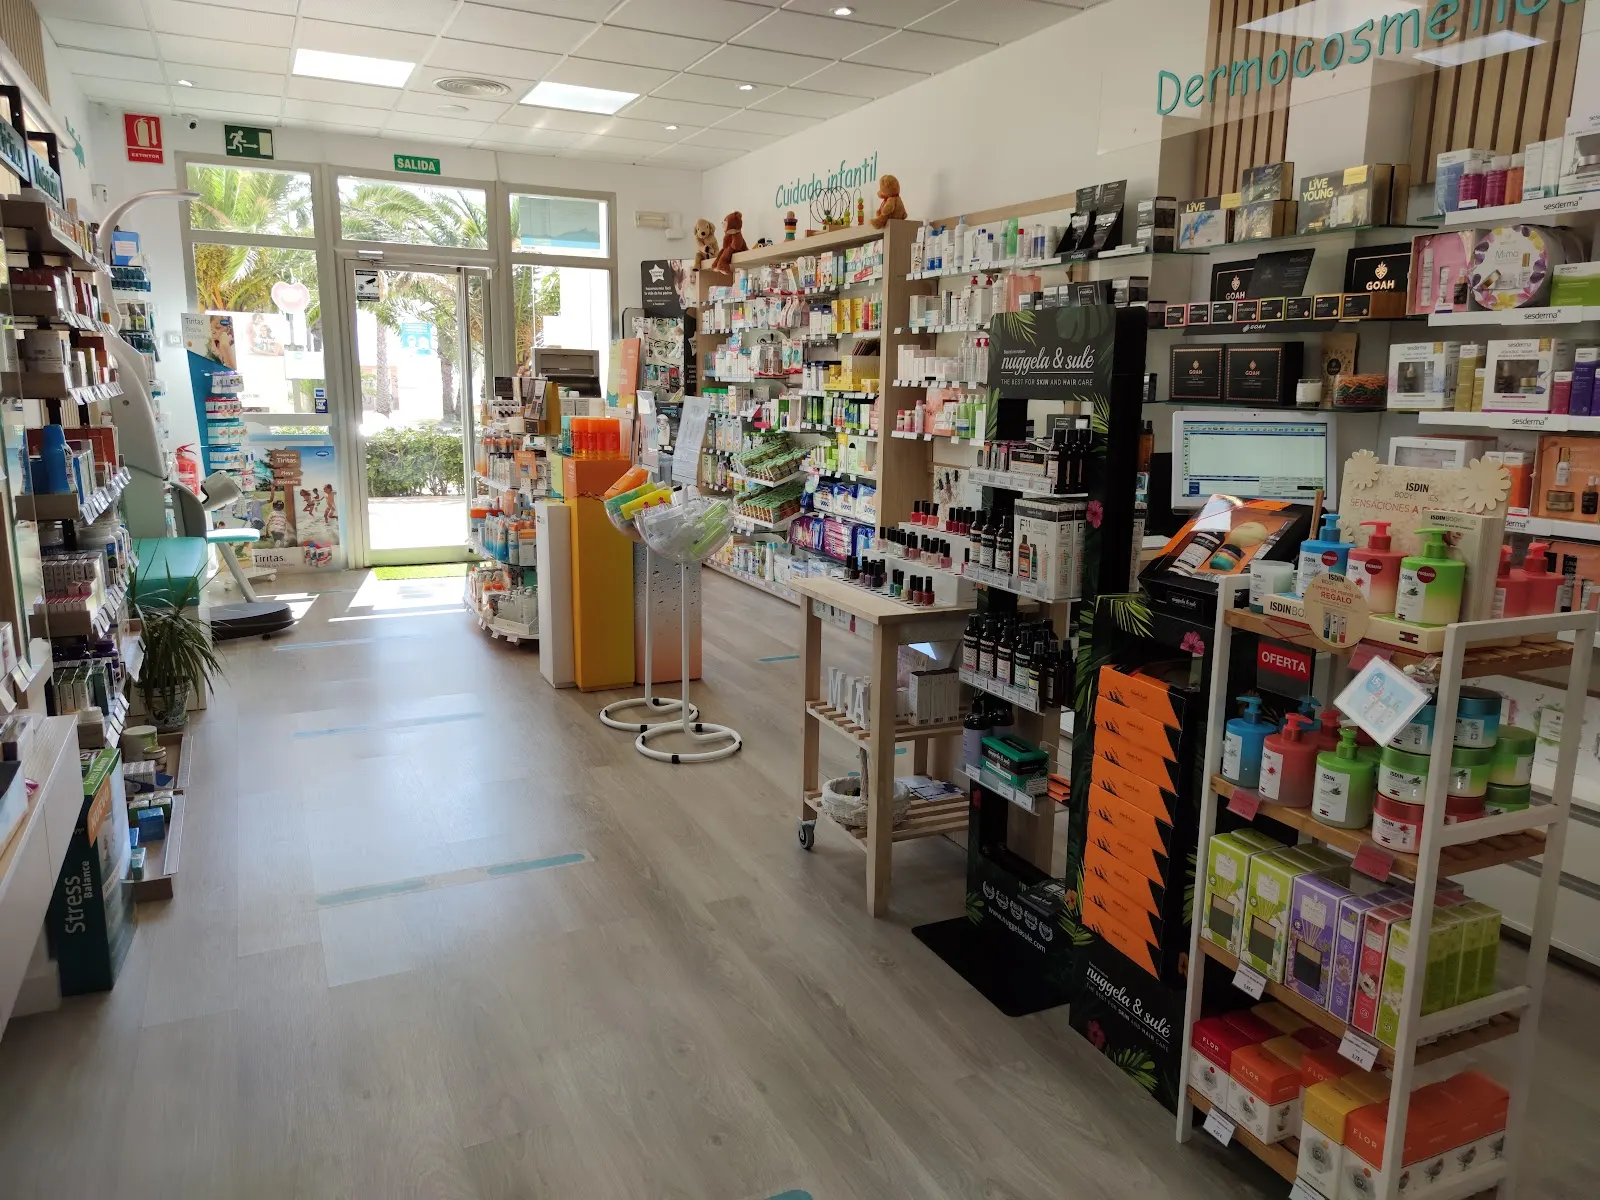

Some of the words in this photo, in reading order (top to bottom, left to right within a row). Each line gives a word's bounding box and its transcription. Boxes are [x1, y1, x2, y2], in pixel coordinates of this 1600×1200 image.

[1157, 0, 1583, 116] Dermocosme
[397, 157, 436, 172] SALIDA
[775, 173, 823, 208] Cuidado
[827, 151, 878, 193] infantil
[1309, 176, 1329, 190] LIVE
[1303, 187, 1334, 202] YOUNG
[1186, 201, 1206, 213] LIVE
[1543, 200, 1579, 211] sesderma
[1366, 280, 1395, 291] GOAH
[1225, 291, 1245, 300] GOAH
[1523, 310, 1558, 320] sesderma
[1001, 346, 1051, 375] nuggela
[1052, 347, 1065, 369] &
[1065, 344, 1096, 370] sulé
[1001, 378, 1010, 386] THE
[1011, 378, 1024, 386] BEST
[1024, 378, 1035, 386] FOR
[1036, 378, 1049, 386] SKIN
[1050, 378, 1062, 386] AND
[1062, 378, 1077, 386] HAIR
[1077, 378, 1093, 386] CARE
[1511, 416, 1545, 426] sesderma
[1405, 482, 1429, 493] ISDIN
[1412, 506, 1419, 514] A
[1504, 519, 1526, 528] derma
[253, 554, 284, 563] Tiritas
[1328, 573, 1345, 583] ISDIN
[1401, 574, 1413, 582] ISDIN
[1320, 591, 1352, 605] REGALO
[1261, 650, 1307, 675] OFERTA
[1322, 773, 1336, 782] ISDIN
[1389, 771, 1404, 779] ISDIN
[1381, 818, 1395, 827] ISDIN
[83, 860, 93, 899] Balance
[65, 875, 86, 934] Stress
[1086, 966, 1132, 1009] nuggela
[1132, 999, 1144, 1017] &
[1143, 1011, 1171, 1038] sulé
[1202, 1036, 1220, 1052] FLOR
[1241, 1065, 1260, 1082] FLOR
[1307, 1066, 1329, 1081] FLO
[1352, 1127, 1377, 1149] FLOR
